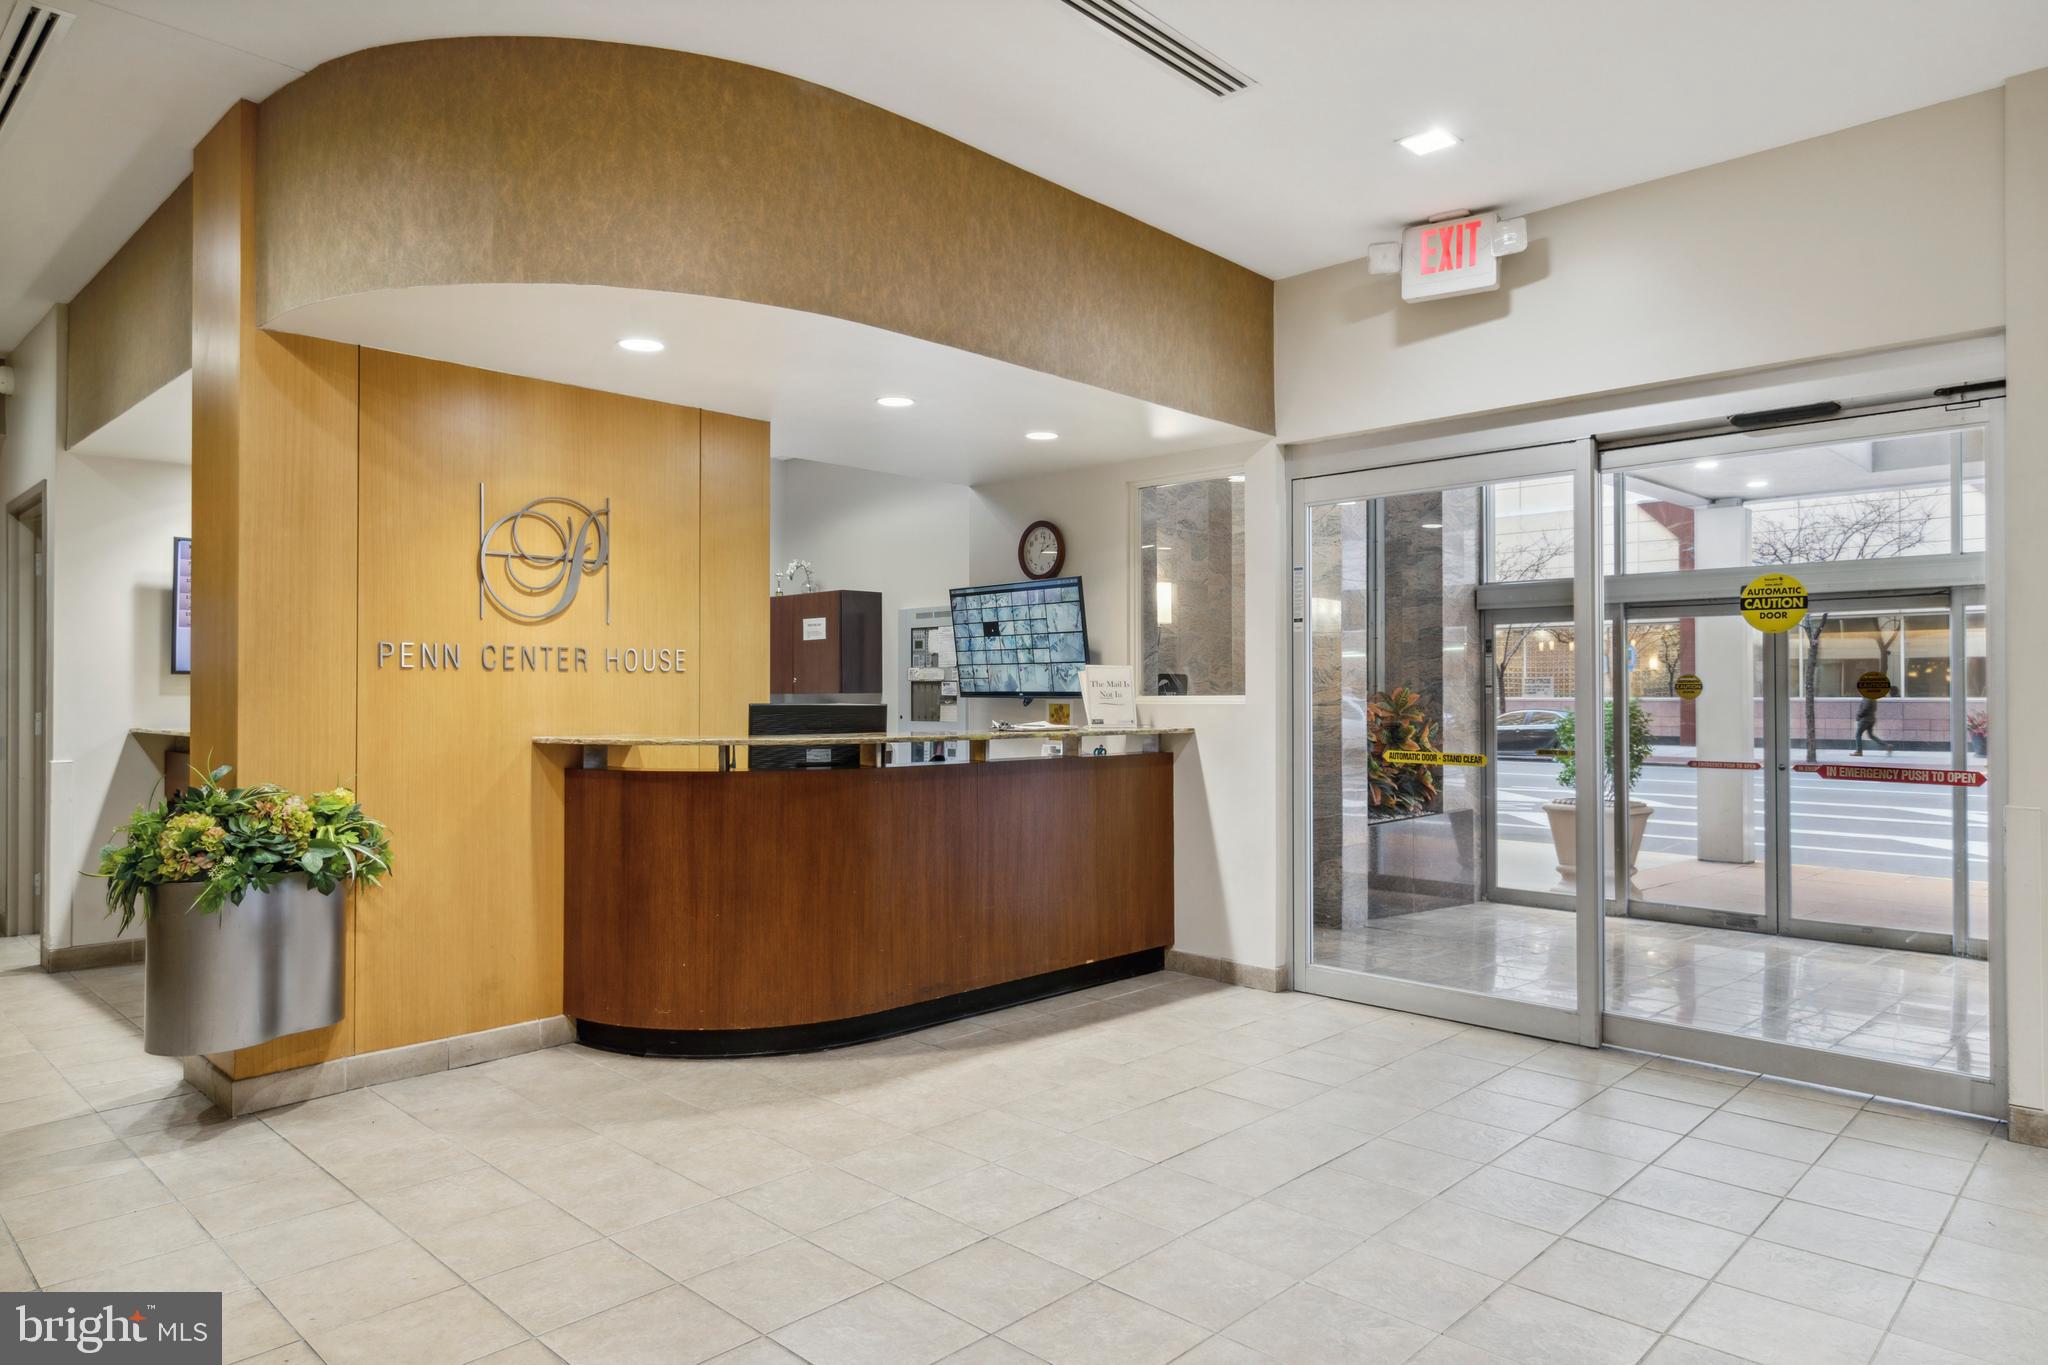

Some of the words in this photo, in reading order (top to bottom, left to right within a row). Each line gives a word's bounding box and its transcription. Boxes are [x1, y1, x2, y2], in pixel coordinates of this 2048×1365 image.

[1420, 219, 1482, 276] EXIT
[1747, 586, 1802, 596] AUTOMATIC
[1744, 597, 1804, 609] CAUTION
[1759, 611, 1788, 619] DOOR
[376, 640, 461, 670] PENN
[480, 644, 588, 673] CENTER
[605, 648, 688, 674] HOUSE
[1388, 752, 1421, 761] AUTOMATIC
[1422, 753, 1438, 761] DOOR
[1443, 754, 1462, 763] STAND
[1464, 755, 1483, 764] CLEAR
[1826, 765, 1837, 777] IN
[1839, 766, 1900, 779] EMERGENCY
[1901, 769, 1929, 781] PUSH
[1932, 771, 1944, 782] TO
[1947, 772, 1976, 784] OPEN
